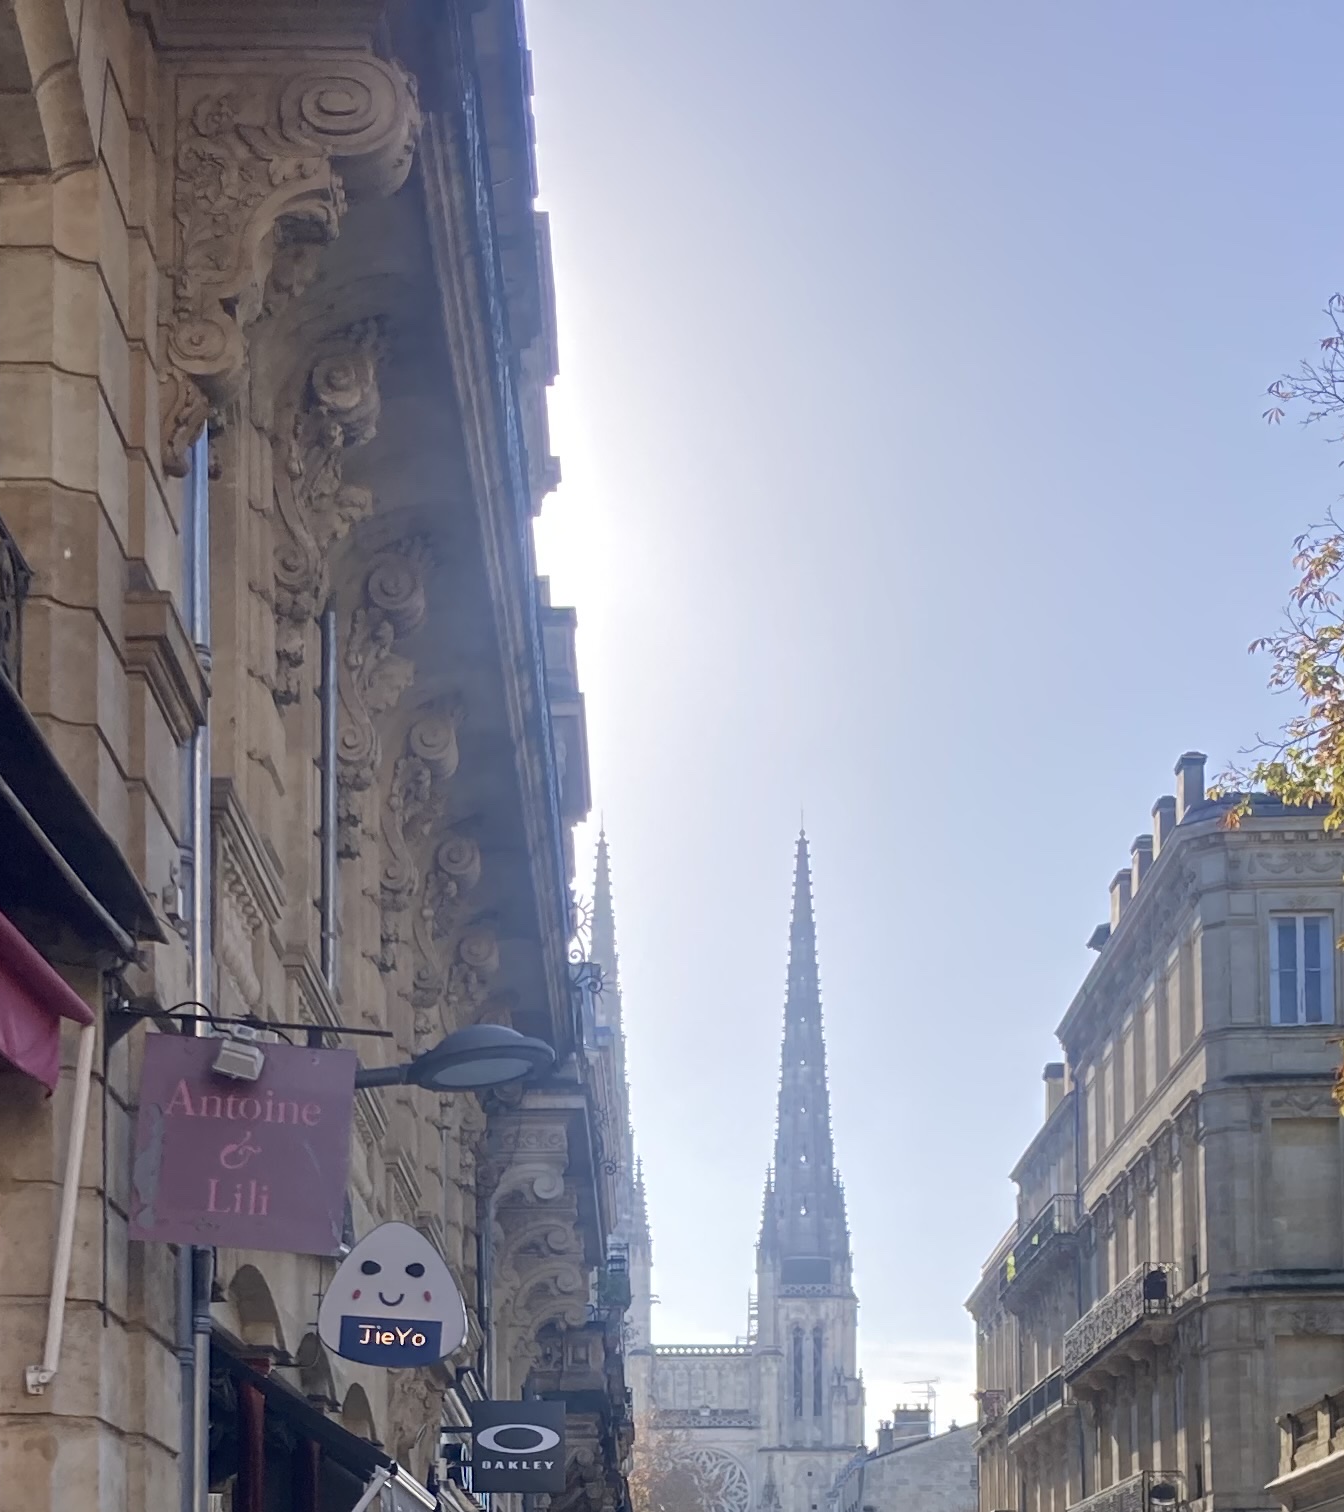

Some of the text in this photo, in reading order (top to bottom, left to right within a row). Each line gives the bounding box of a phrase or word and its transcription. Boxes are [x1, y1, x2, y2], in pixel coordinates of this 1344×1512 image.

[164, 1078, 322, 1126] Antoine
[219, 1131, 263, 1170] &
[207, 1178, 269, 1216] Lili
[358, 1324, 426, 1347] JieYo
[481, 1460, 555, 1470] OAKLEY
